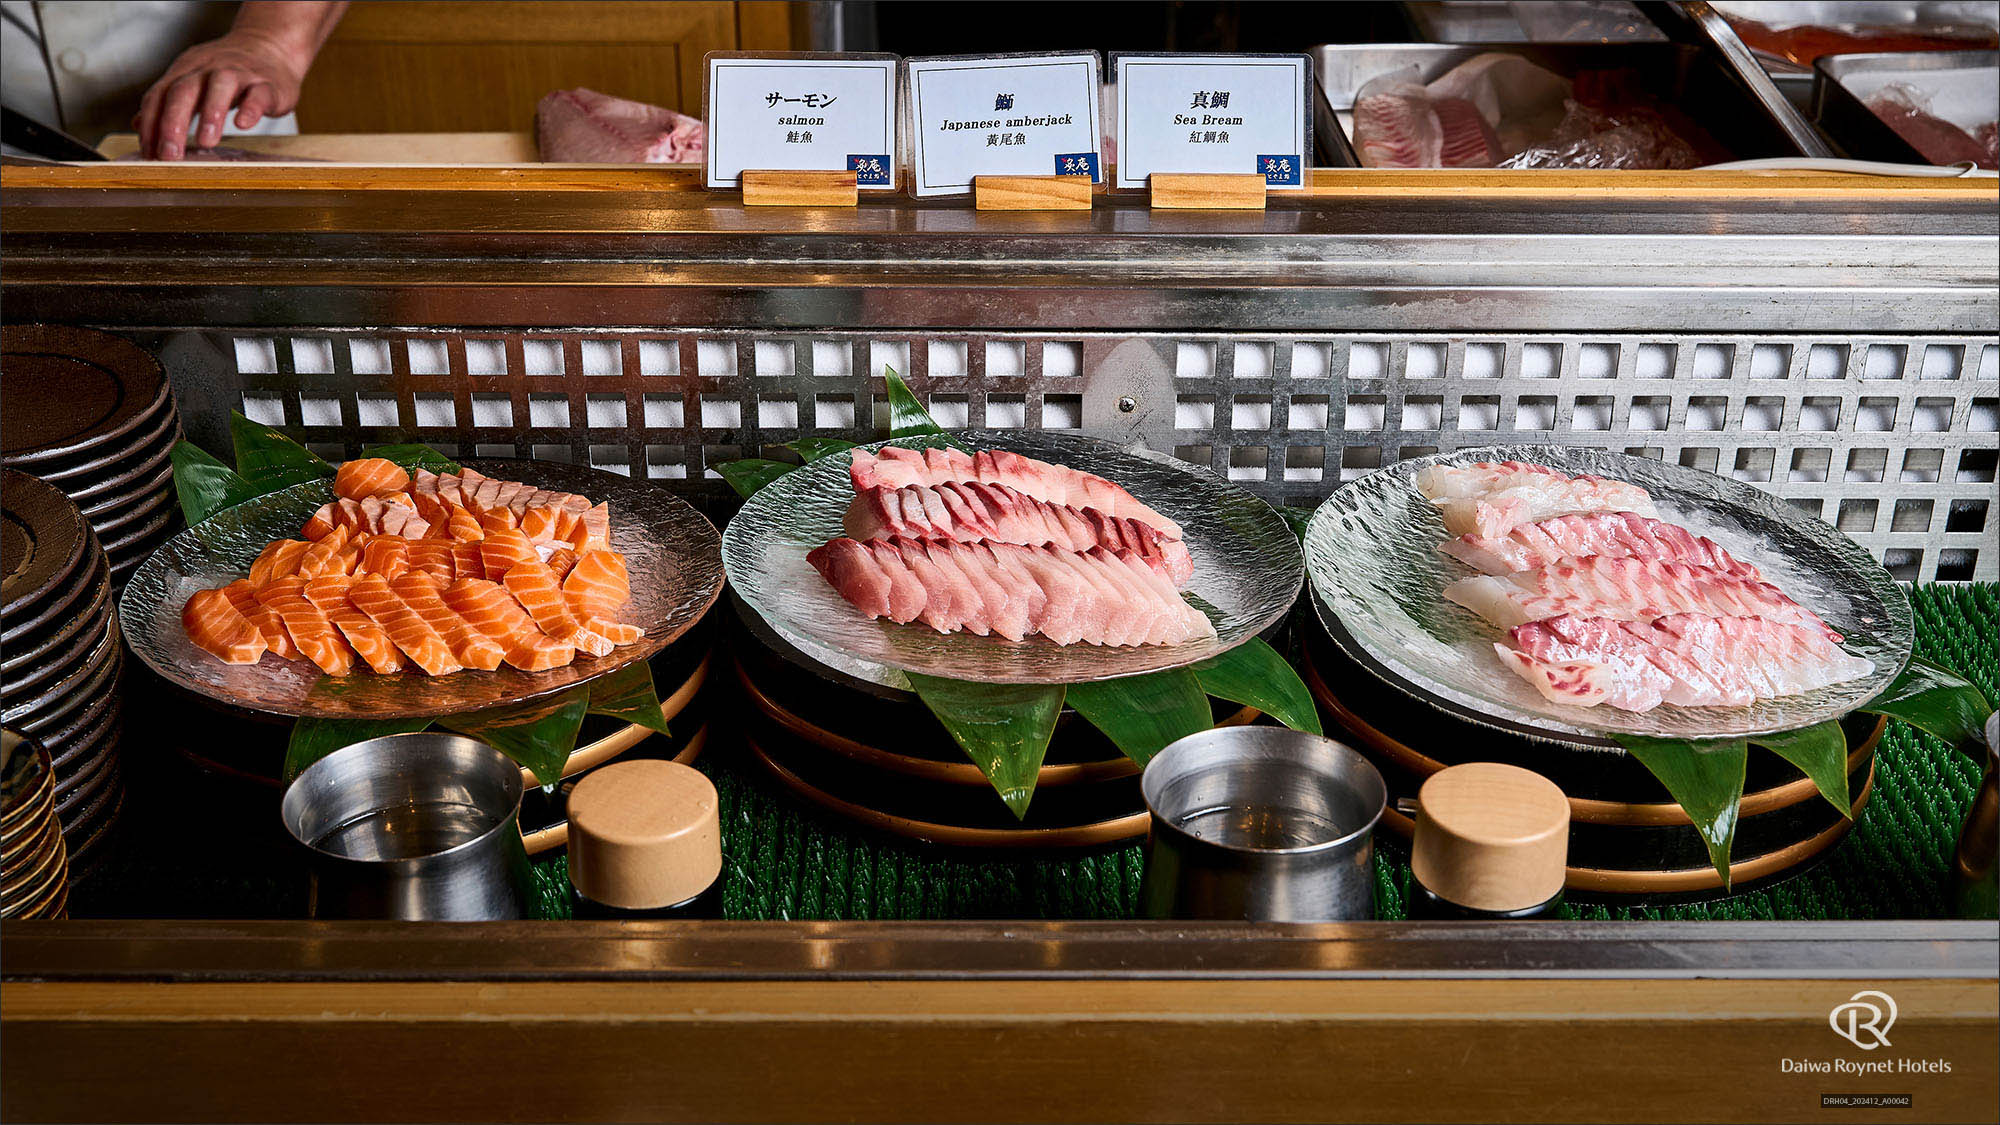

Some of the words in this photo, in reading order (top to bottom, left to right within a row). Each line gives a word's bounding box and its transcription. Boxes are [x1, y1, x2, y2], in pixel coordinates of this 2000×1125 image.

[765, 92, 837, 109] サーモン
[994, 93, 1014, 111] 鰤
[1190, 91, 1230, 109] 真鯛
[778, 115, 825, 125] salmon
[940, 118, 1000, 132] Japanese
[1005, 114, 1072, 128] amberjack
[1173, 114, 1197, 126] Sea
[1202, 114, 1243, 126] Bream
[785, 130, 813, 144] 鮭魚
[1189, 130, 1229, 143] 紅鯛魚
